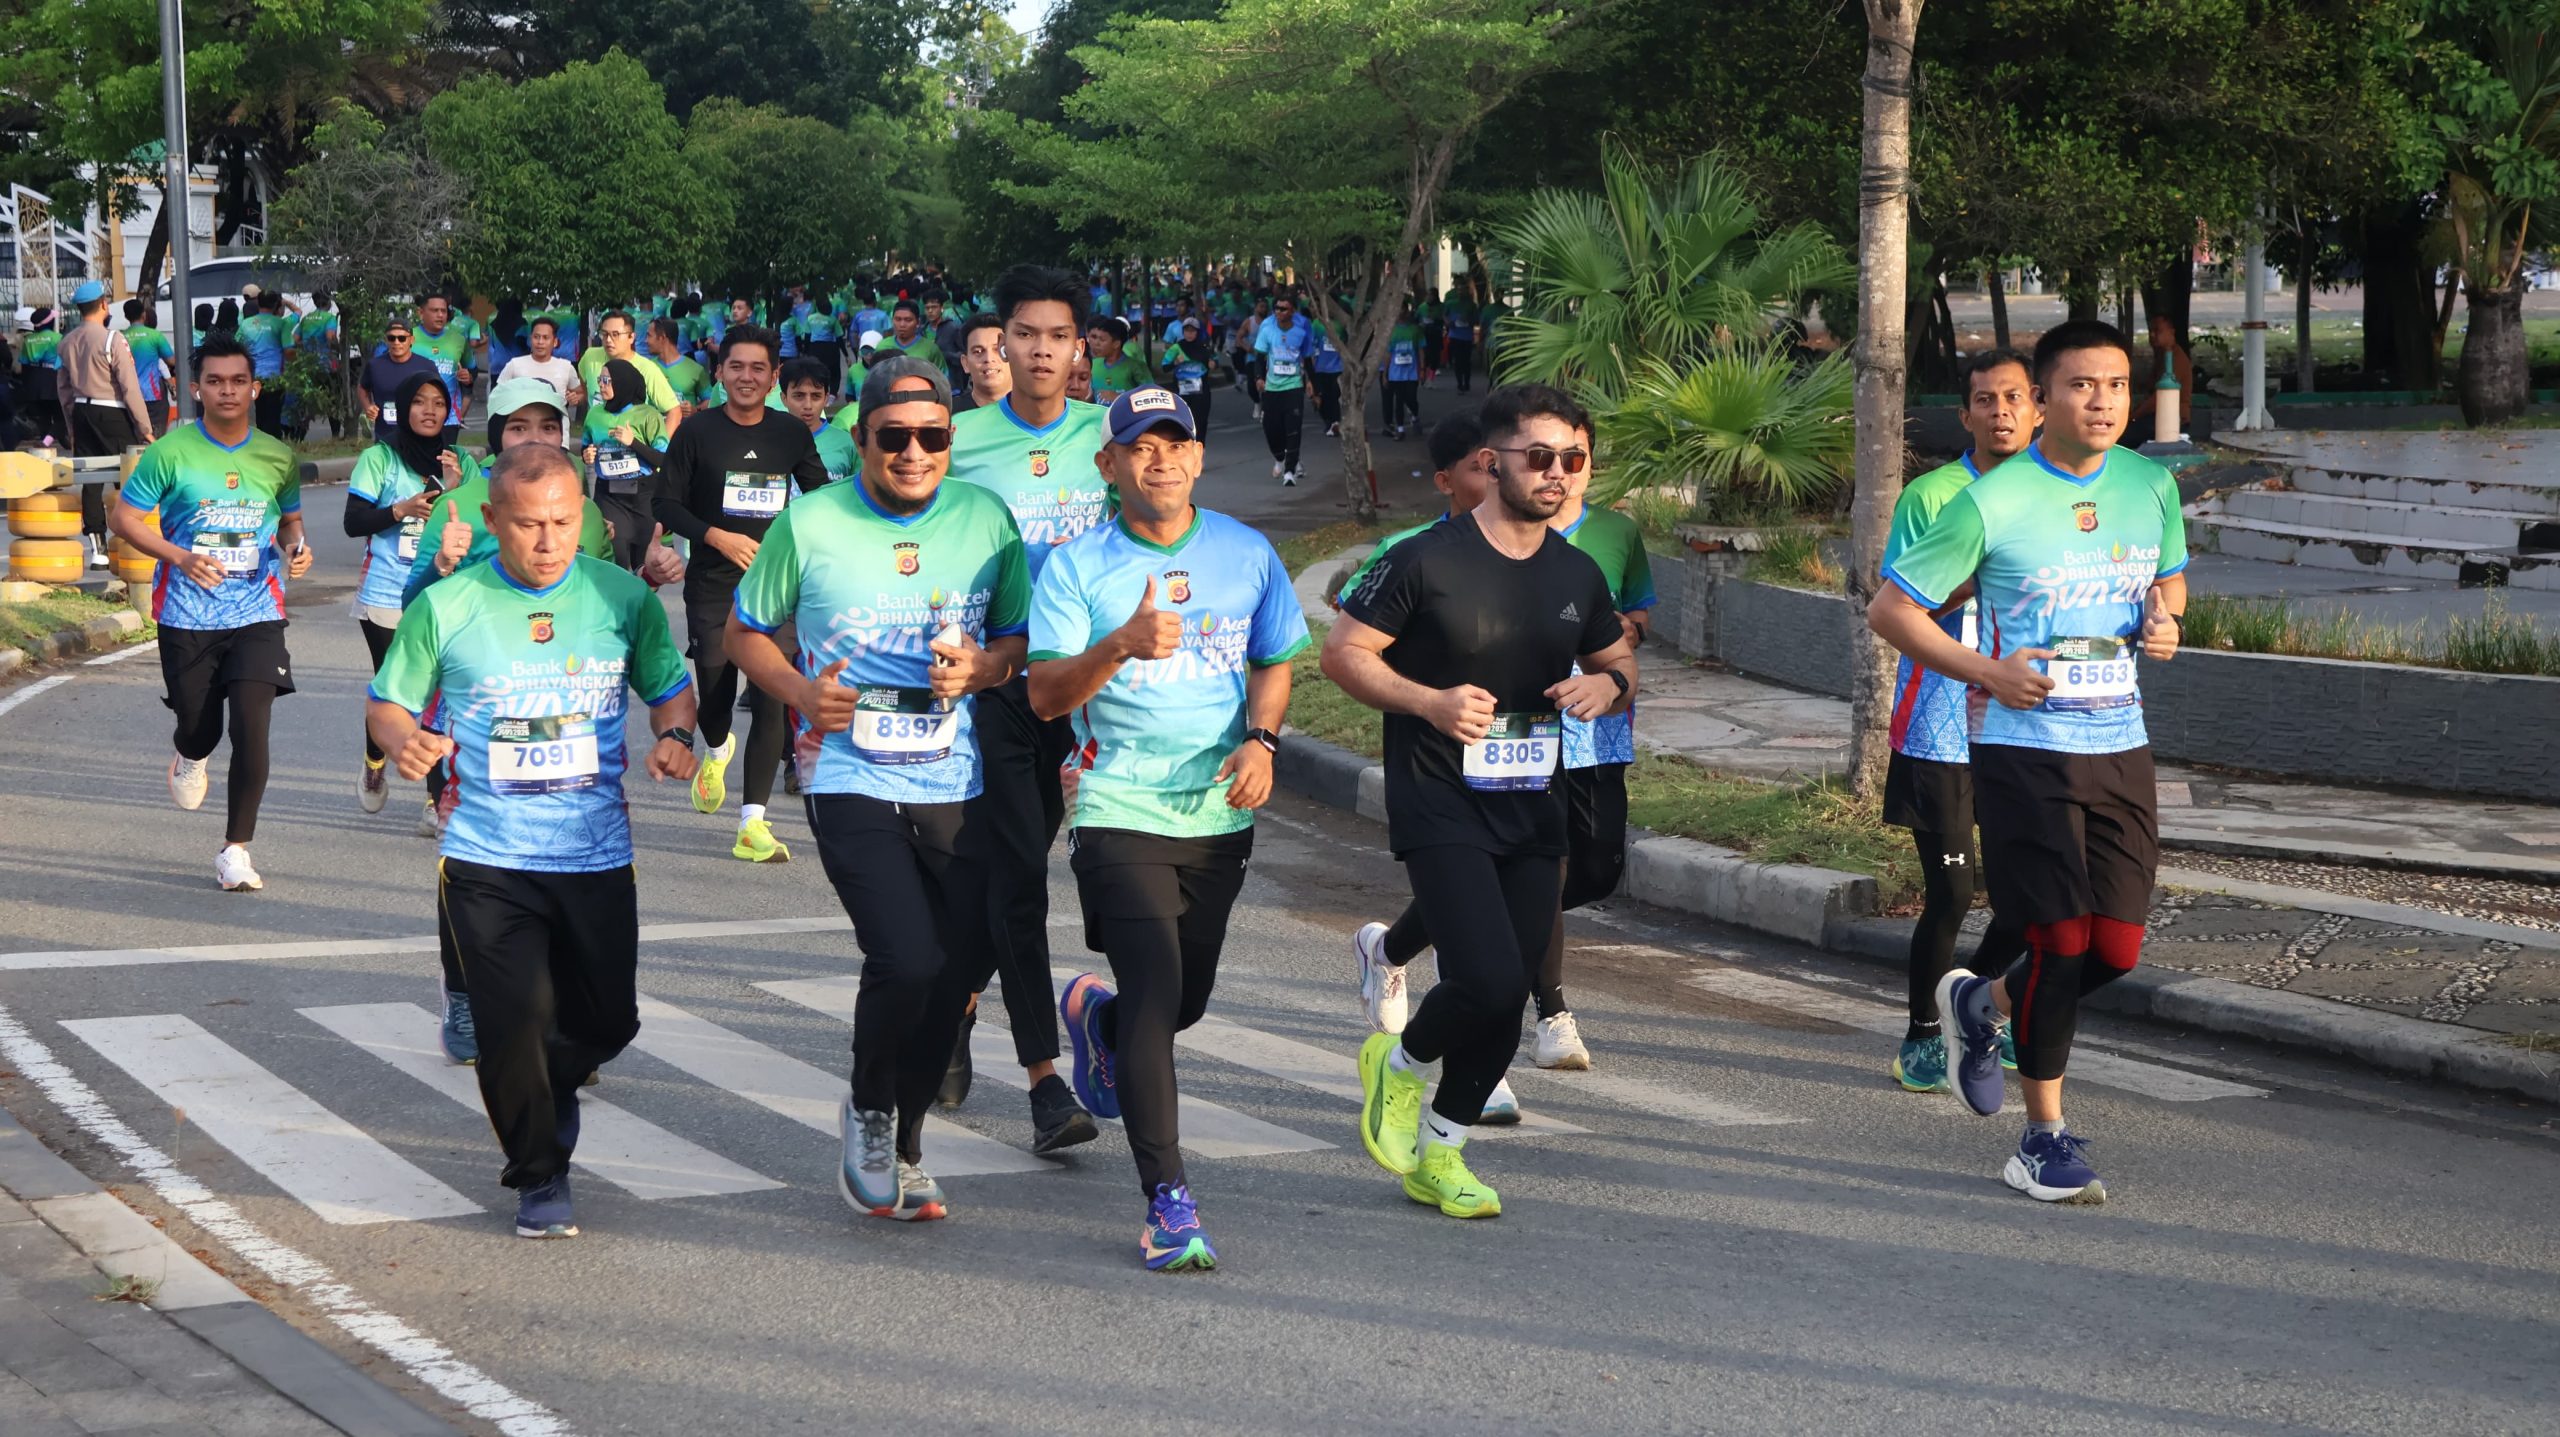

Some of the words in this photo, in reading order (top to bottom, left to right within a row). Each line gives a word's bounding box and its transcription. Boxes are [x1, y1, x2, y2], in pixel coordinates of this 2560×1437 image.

[608, 461, 629, 471] 5137
[246, 500, 268, 509] Aceh
[737, 490, 775, 503] 6451
[1016, 490, 1055, 505] Bank
[1072, 488, 1107, 503] Aceh
[235, 516, 263, 529] 2026
[208, 549, 248, 563] 5316
[2064, 546, 2108, 566] Bank
[2130, 543, 2161, 561] Aceh
[876, 592, 926, 610] Bank
[948, 588, 991, 608] Aceh
[511, 660, 562, 677] Bank
[2068, 663, 2128, 685] 6563
[876, 715, 943, 739] 8397
[1533, 726, 1547, 735] 5KM
[513, 743, 574, 768] 7091
[1484, 741, 1545, 765] 8305
